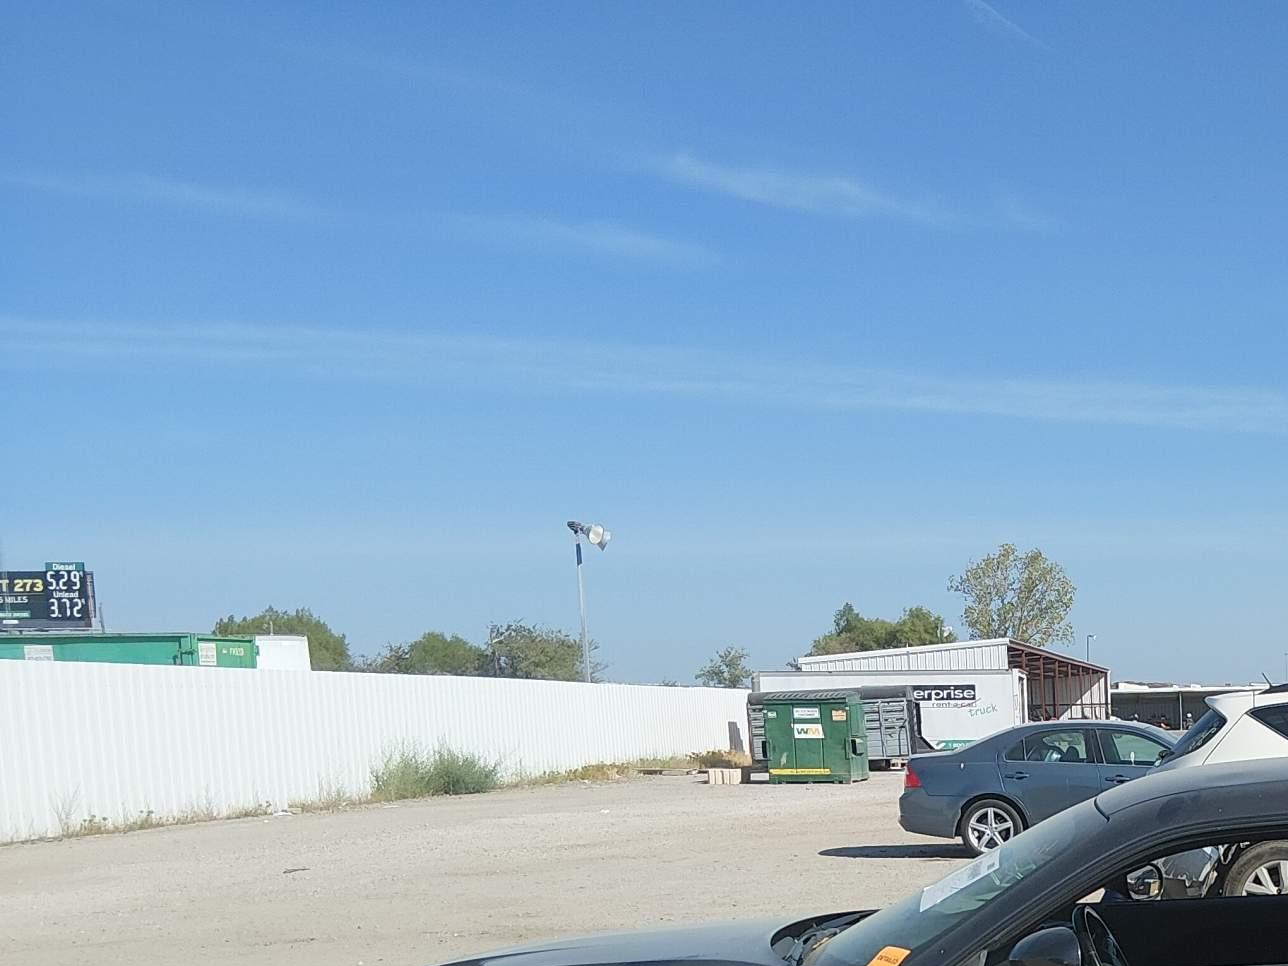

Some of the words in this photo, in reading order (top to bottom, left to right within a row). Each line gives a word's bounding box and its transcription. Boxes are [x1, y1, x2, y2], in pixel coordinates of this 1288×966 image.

[14, 579, 43, 592] 273
[49, 599, 82, 617] 3.72
[968, 703, 998, 717] truck
[796, 727, 821, 736] WM
